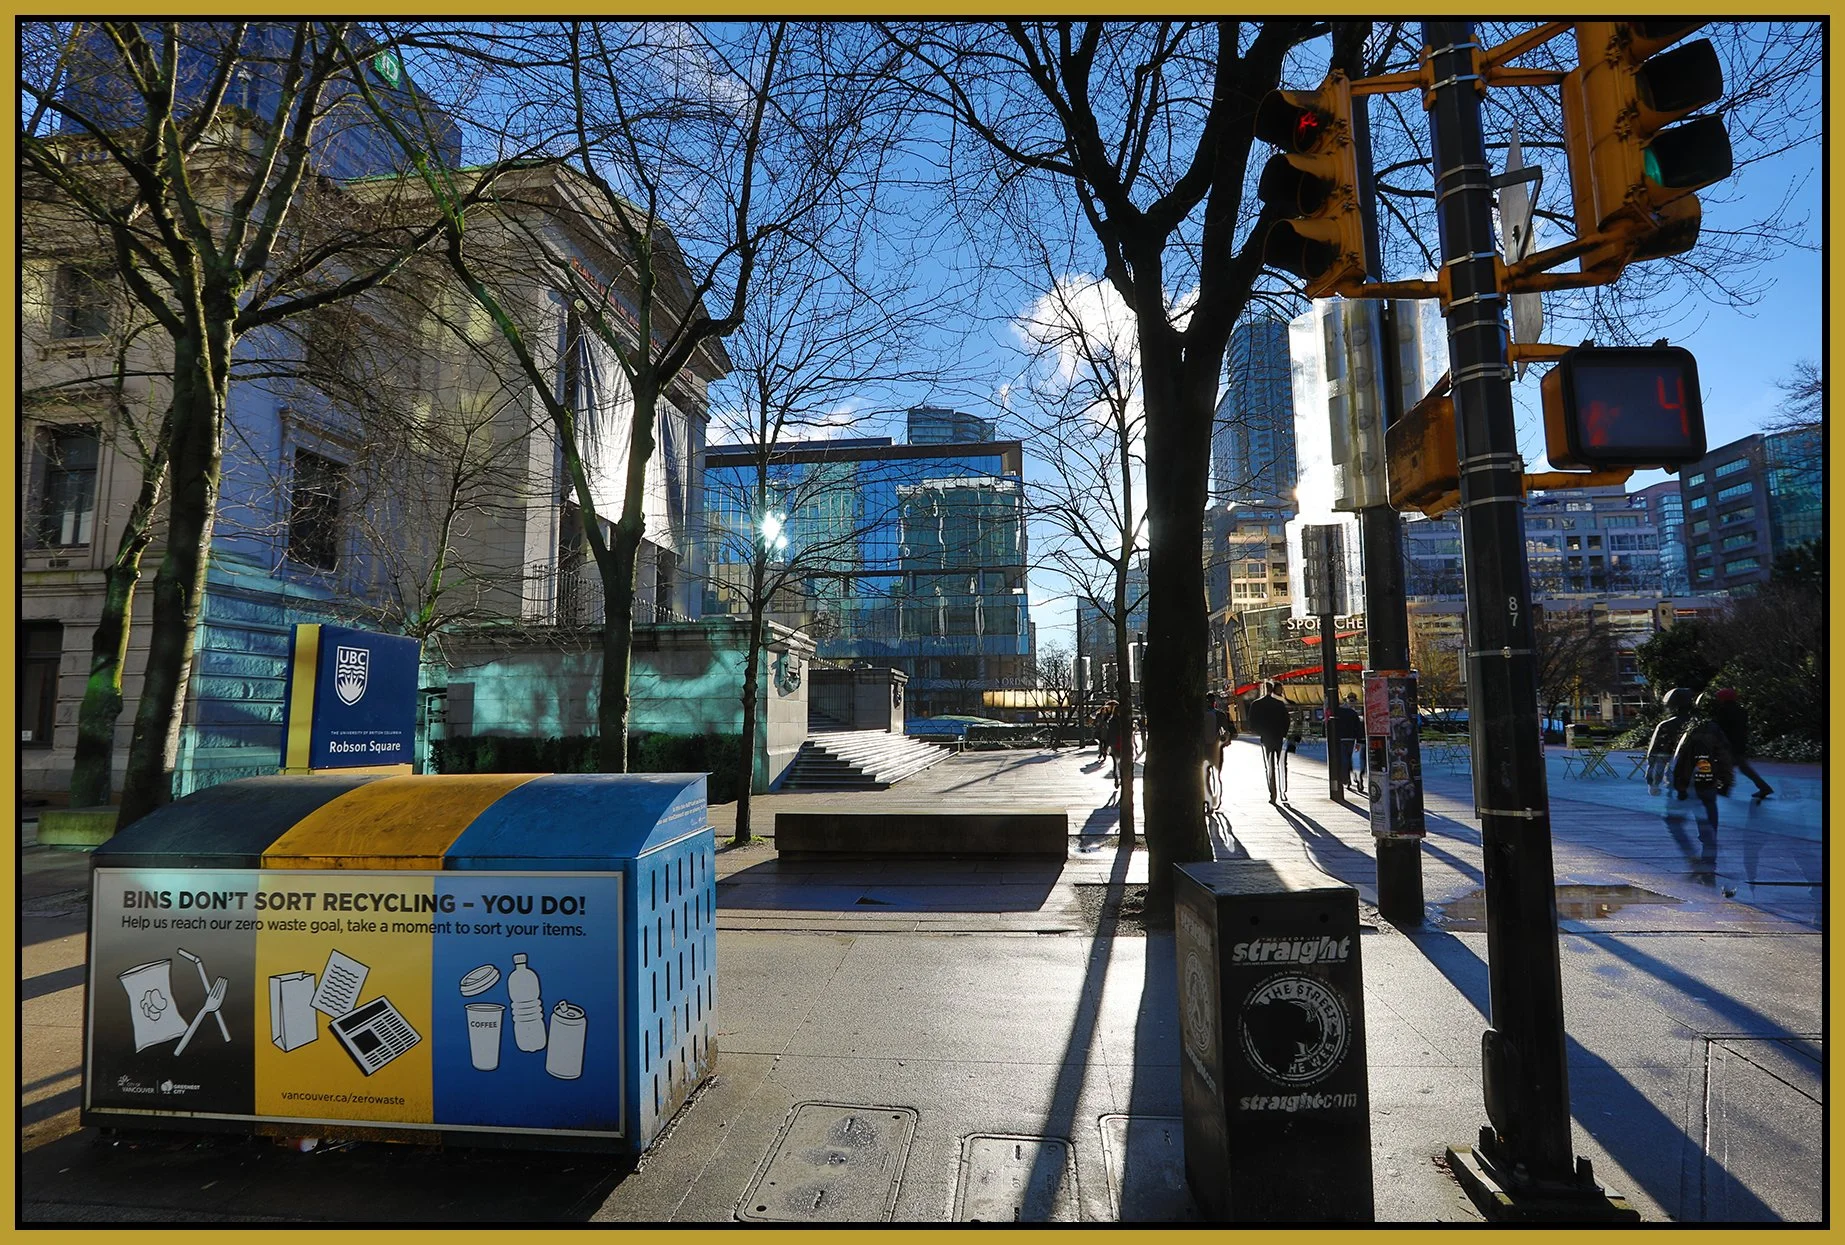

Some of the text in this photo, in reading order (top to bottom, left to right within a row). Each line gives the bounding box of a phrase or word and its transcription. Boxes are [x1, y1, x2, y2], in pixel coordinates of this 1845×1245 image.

[1656, 376, 1690, 437] 4
[340, 650, 366, 665] UBC
[329, 740, 401, 753] Robson Square
[123, 890, 172, 909] BINS
[254, 892, 316, 911] SORT
[323, 893, 456, 913] RECYCLING
[482, 895, 533, 914] YOU
[541, 896, 586, 915] DO!
[121, 916, 587, 938] Help us reach our zero waste goal, take a moment to sort your items.
[1232, 936, 1351, 964] straight
[1264, 984, 1291, 1001] THE
[281, 1091, 405, 1105] vancouver.ca/zerowaste
